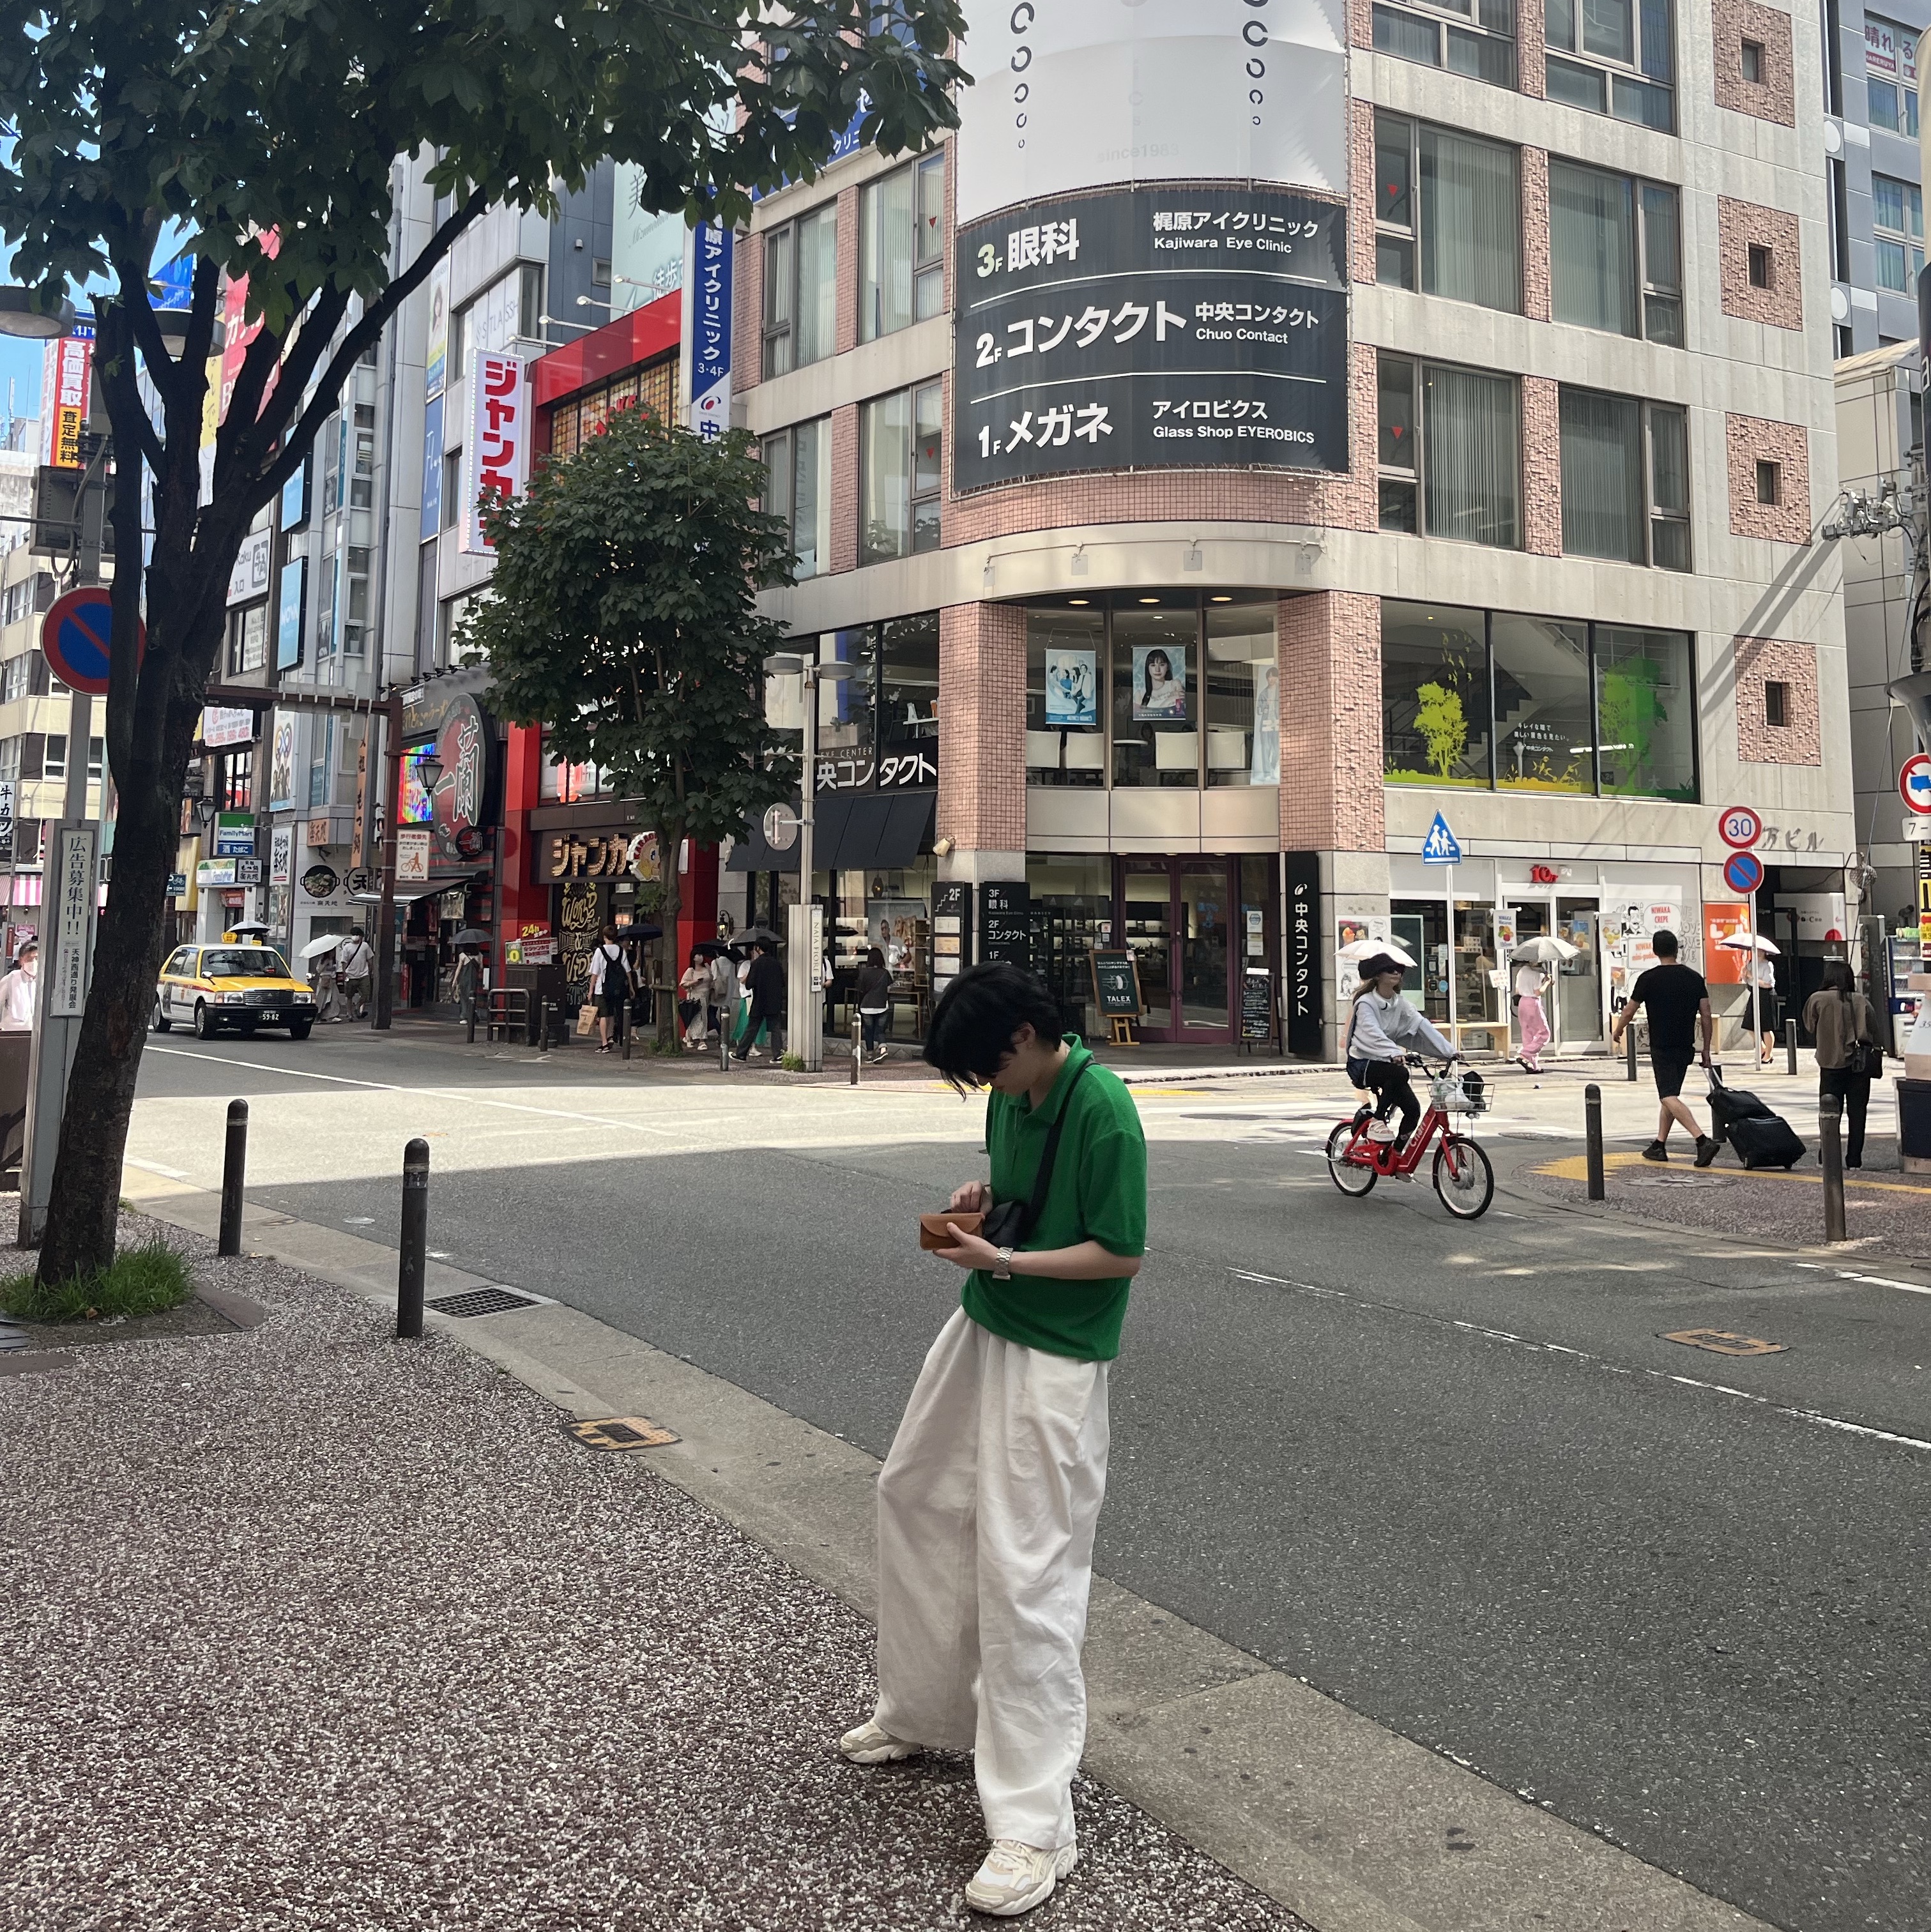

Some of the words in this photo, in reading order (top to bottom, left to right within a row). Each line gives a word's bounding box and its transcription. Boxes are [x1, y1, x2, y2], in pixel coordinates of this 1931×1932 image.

[1152, 211, 1319, 238] 梶原アイクリニック
[977, 244, 1004, 277] 3F
[1007, 218, 1080, 271] 眼科
[1154, 237, 1219, 250] Kajiwara
[1226, 237, 1253, 250] Eye
[1256, 238, 1292, 254] Clinic
[653, 257, 683, 299] 徒歩
[1195, 301, 1320, 329] 中央コンタクト
[976, 333, 1002, 369] 2F
[1007, 301, 1187, 358] コンタクト
[1196, 328, 1233, 340] Chuo
[1236, 328, 1288, 344] Contact
[60, 340, 86, 406] 高価買取
[1152, 400, 1269, 420] アイロビクス
[60, 411, 80, 463] 査定無料
[979, 425, 1002, 459] 1F
[1005, 402, 1113, 453] メガネ
[1153, 425, 1194, 439] Glass
[1197, 425, 1233, 439] Shop
[1237, 425, 1315, 444] EYEROBICS
[480, 360, 517, 547] ジャンカ
[840, 746, 873, 758] CENTER
[794, 752, 937, 791] 央コンタクト
[1729, 818, 1752, 837] 30
[949, 888, 961, 902] 2F
[988, 889, 1000, 898] 3F
[988, 899, 1009, 910] 眼科
[1651, 906, 1671, 914] NIWAKA
[988, 920, 1000, 929] 2F
[1654, 915, 1668, 924] CREPE
[988, 930, 1027, 941] コンタクト
[989, 950, 1000, 960] 1F
[1635, 941, 1653, 950] NIWAK
[1295, 902, 1309, 1017] 中央コンタクト
